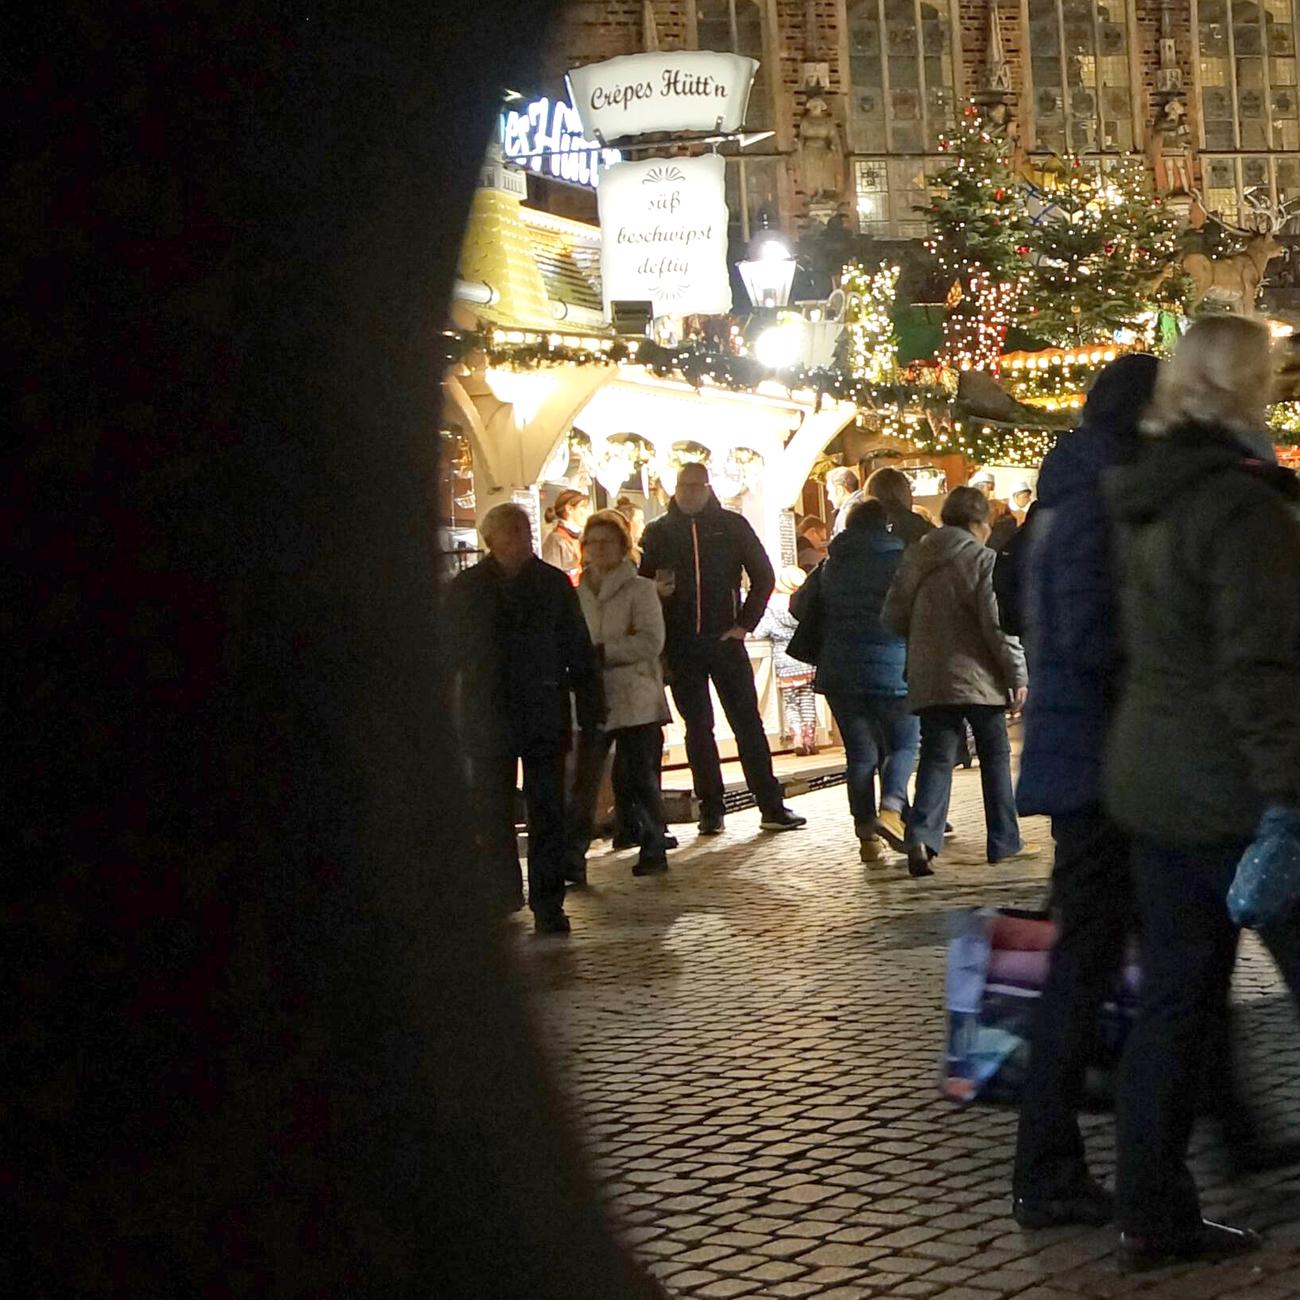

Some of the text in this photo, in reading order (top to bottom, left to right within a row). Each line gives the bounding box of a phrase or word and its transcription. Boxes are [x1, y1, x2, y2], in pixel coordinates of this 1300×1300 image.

[648, 190, 681, 214] süß
[617, 224, 712, 246] beschwipst
[637, 256, 688, 279] deftig
